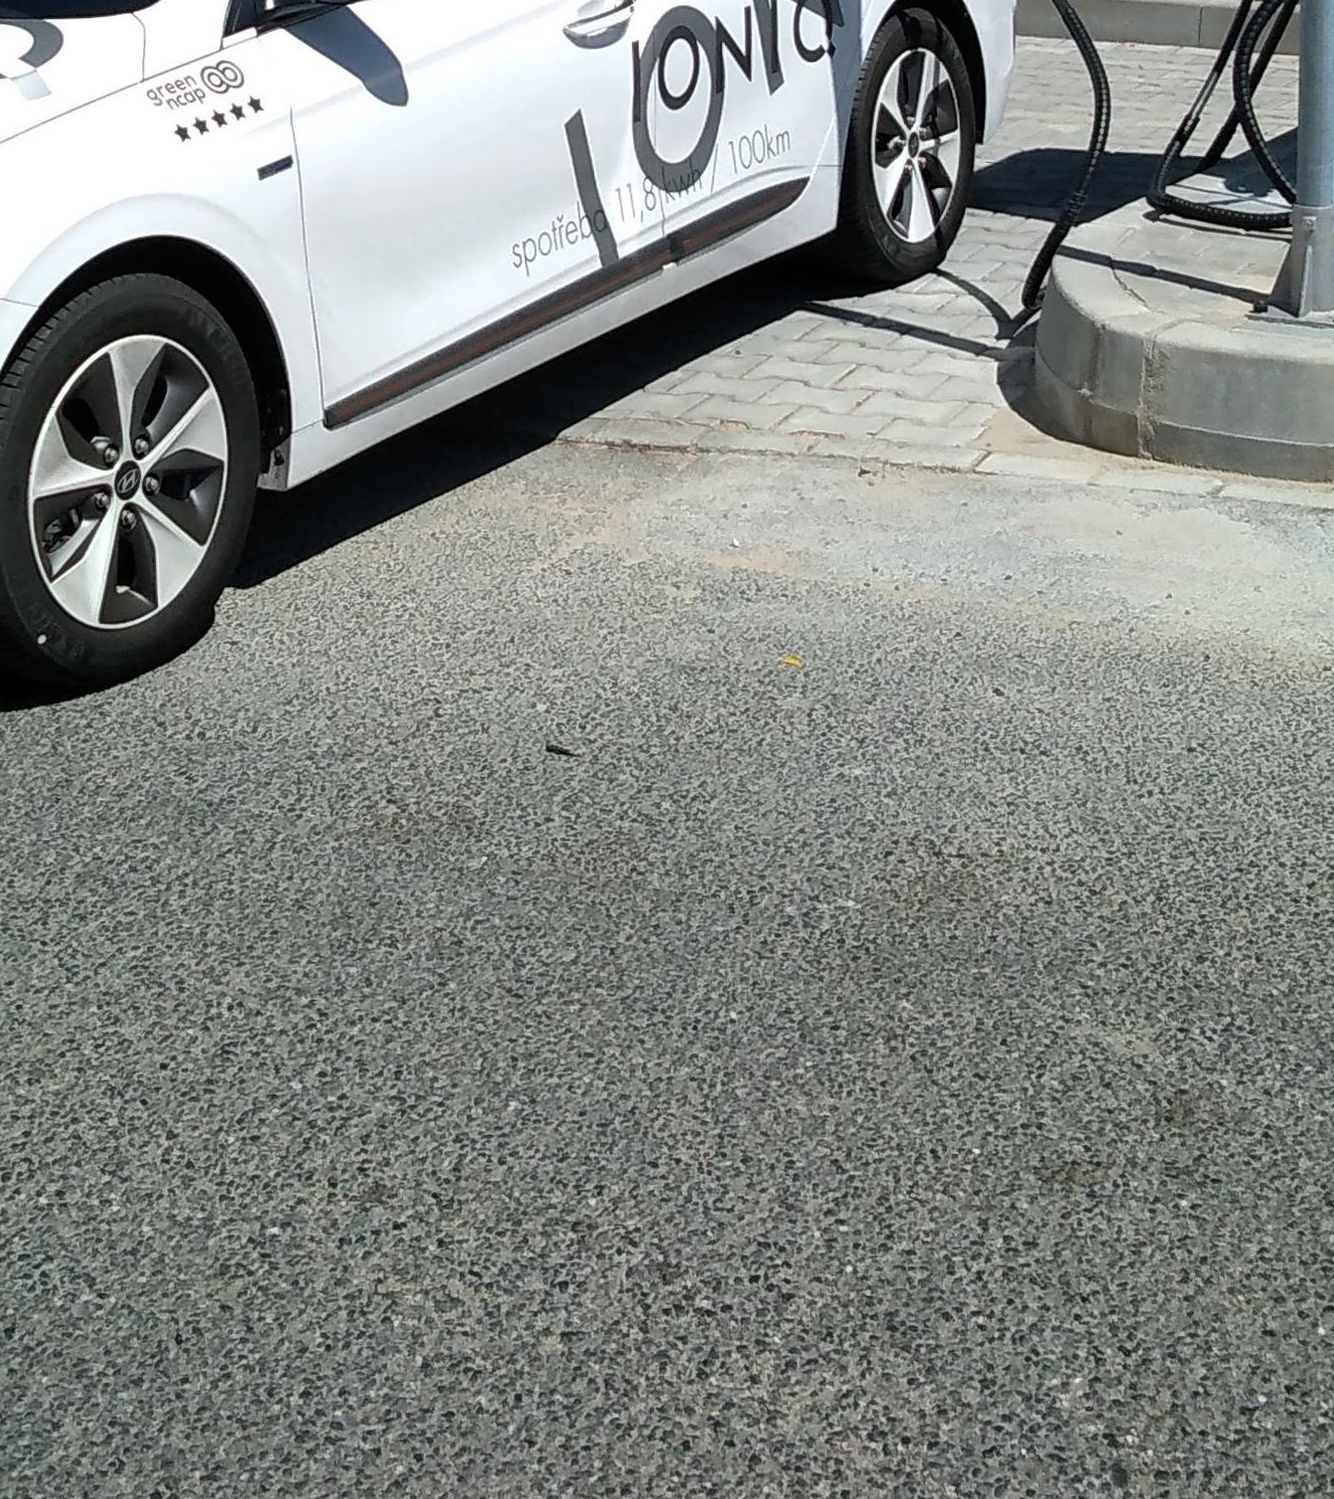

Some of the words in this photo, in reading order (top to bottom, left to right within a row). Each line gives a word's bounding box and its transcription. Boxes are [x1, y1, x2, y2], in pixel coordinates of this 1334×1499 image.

[146, 75, 198, 107] green
[167, 87, 206, 110] ncap
[512, 201, 609, 276] spotřeba
[616, 177, 657, 223] 11,8
